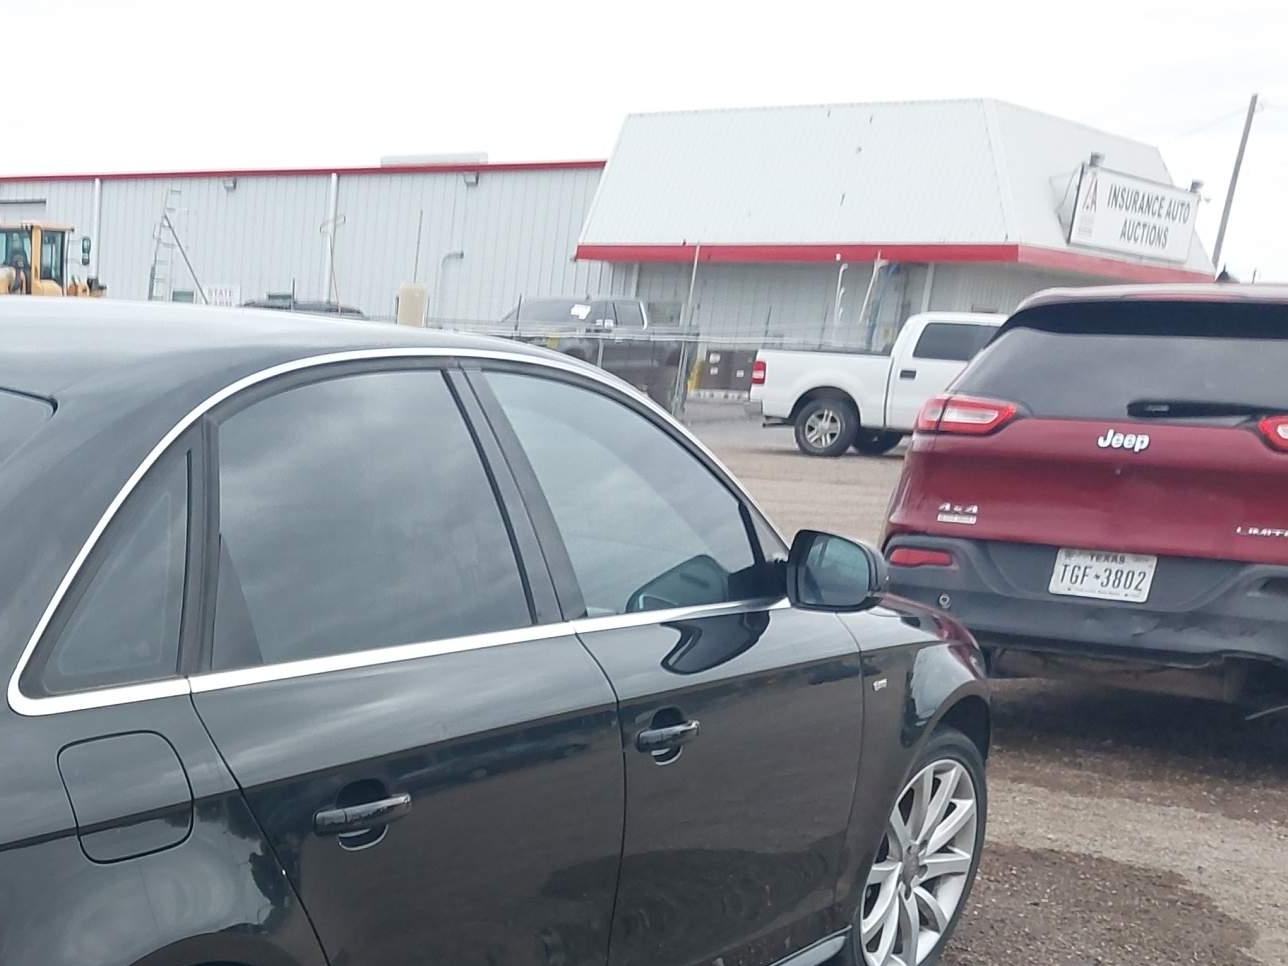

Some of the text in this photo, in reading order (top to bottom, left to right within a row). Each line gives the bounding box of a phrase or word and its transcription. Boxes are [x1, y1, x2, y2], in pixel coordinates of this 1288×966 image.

[1107, 183, 1164, 218] INSURANCE
[1165, 200, 1191, 224] AUTO
[1120, 218, 1169, 249] AUCTIONS
[1097, 428, 1151, 453] Jeep
[1090, 554, 1126, 565] TEXAS
